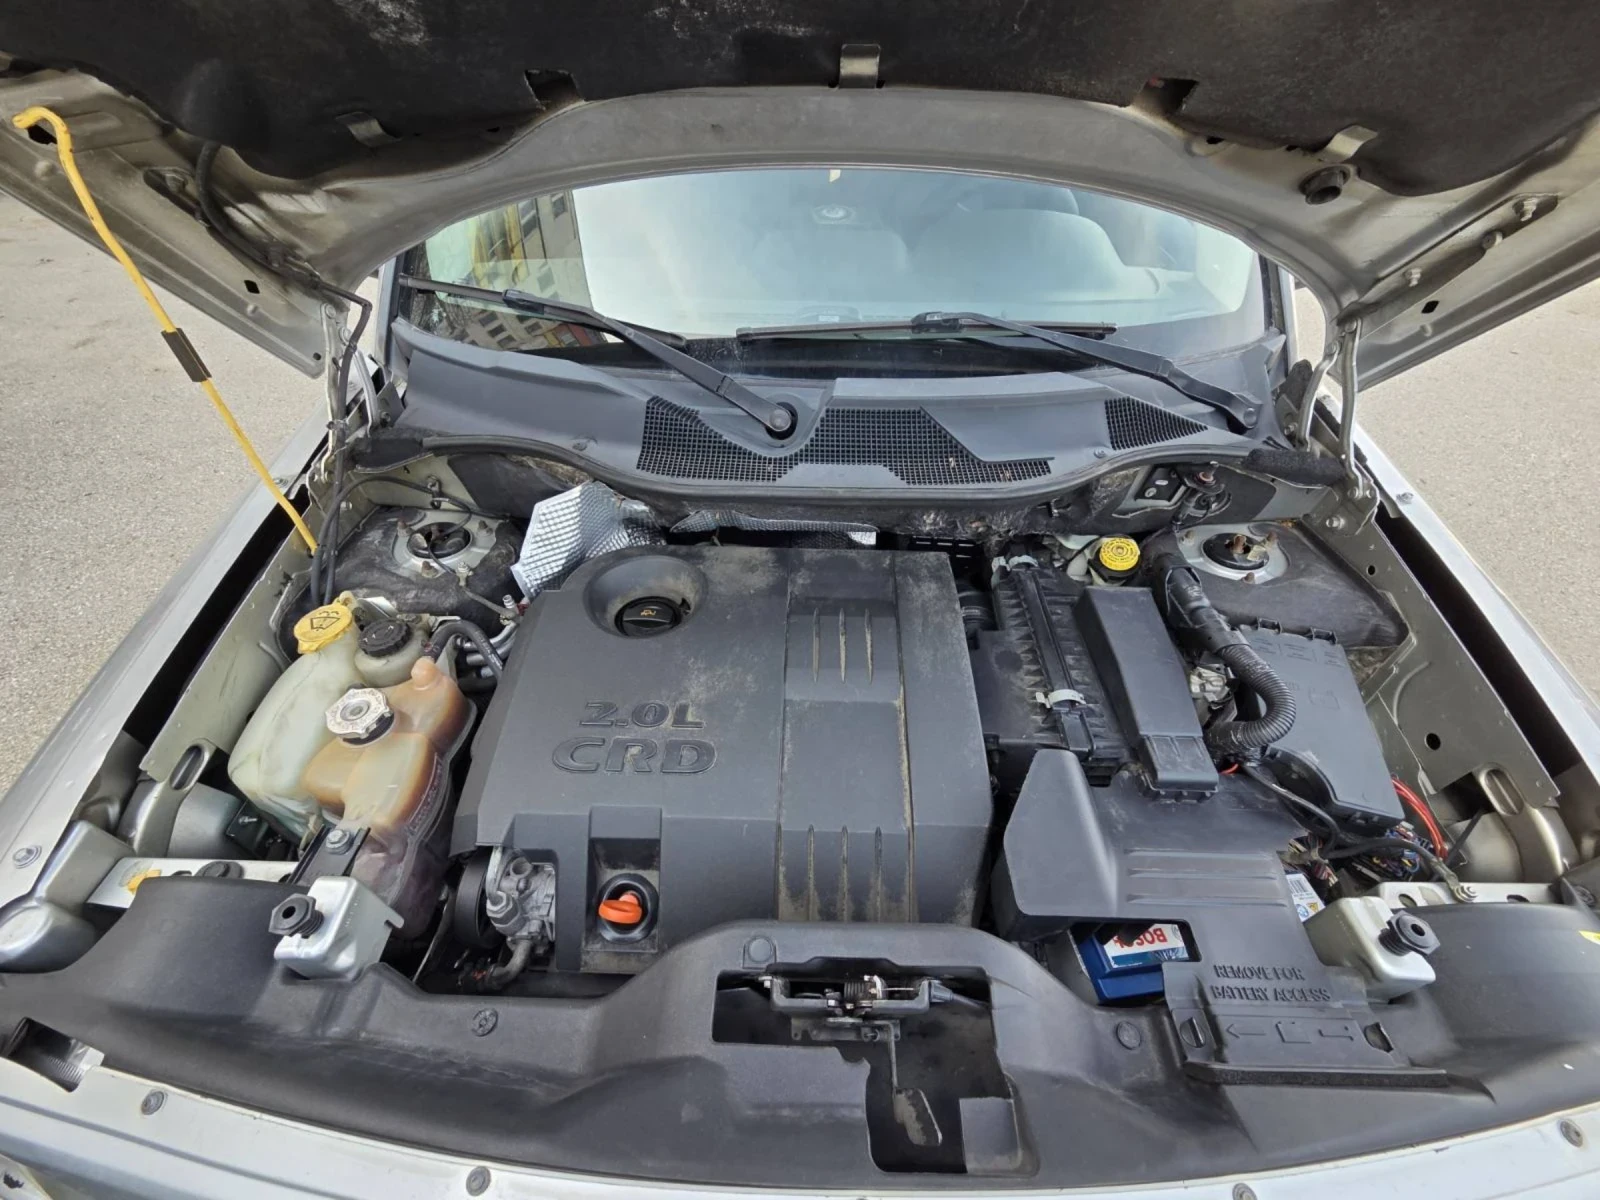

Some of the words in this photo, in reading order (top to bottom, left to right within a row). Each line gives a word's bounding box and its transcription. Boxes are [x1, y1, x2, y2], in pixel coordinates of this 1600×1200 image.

[579, 701, 704, 729] 2.0L
[552, 736, 717, 774] CRD
[1113, 927, 1167, 949] BOS
[1213, 964, 1272, 981] REMOVE
[1272, 966, 1306, 981] FOR
[1209, 985, 1271, 1001] BATTERY
[1273, 987, 1331, 1002] ACCESS
